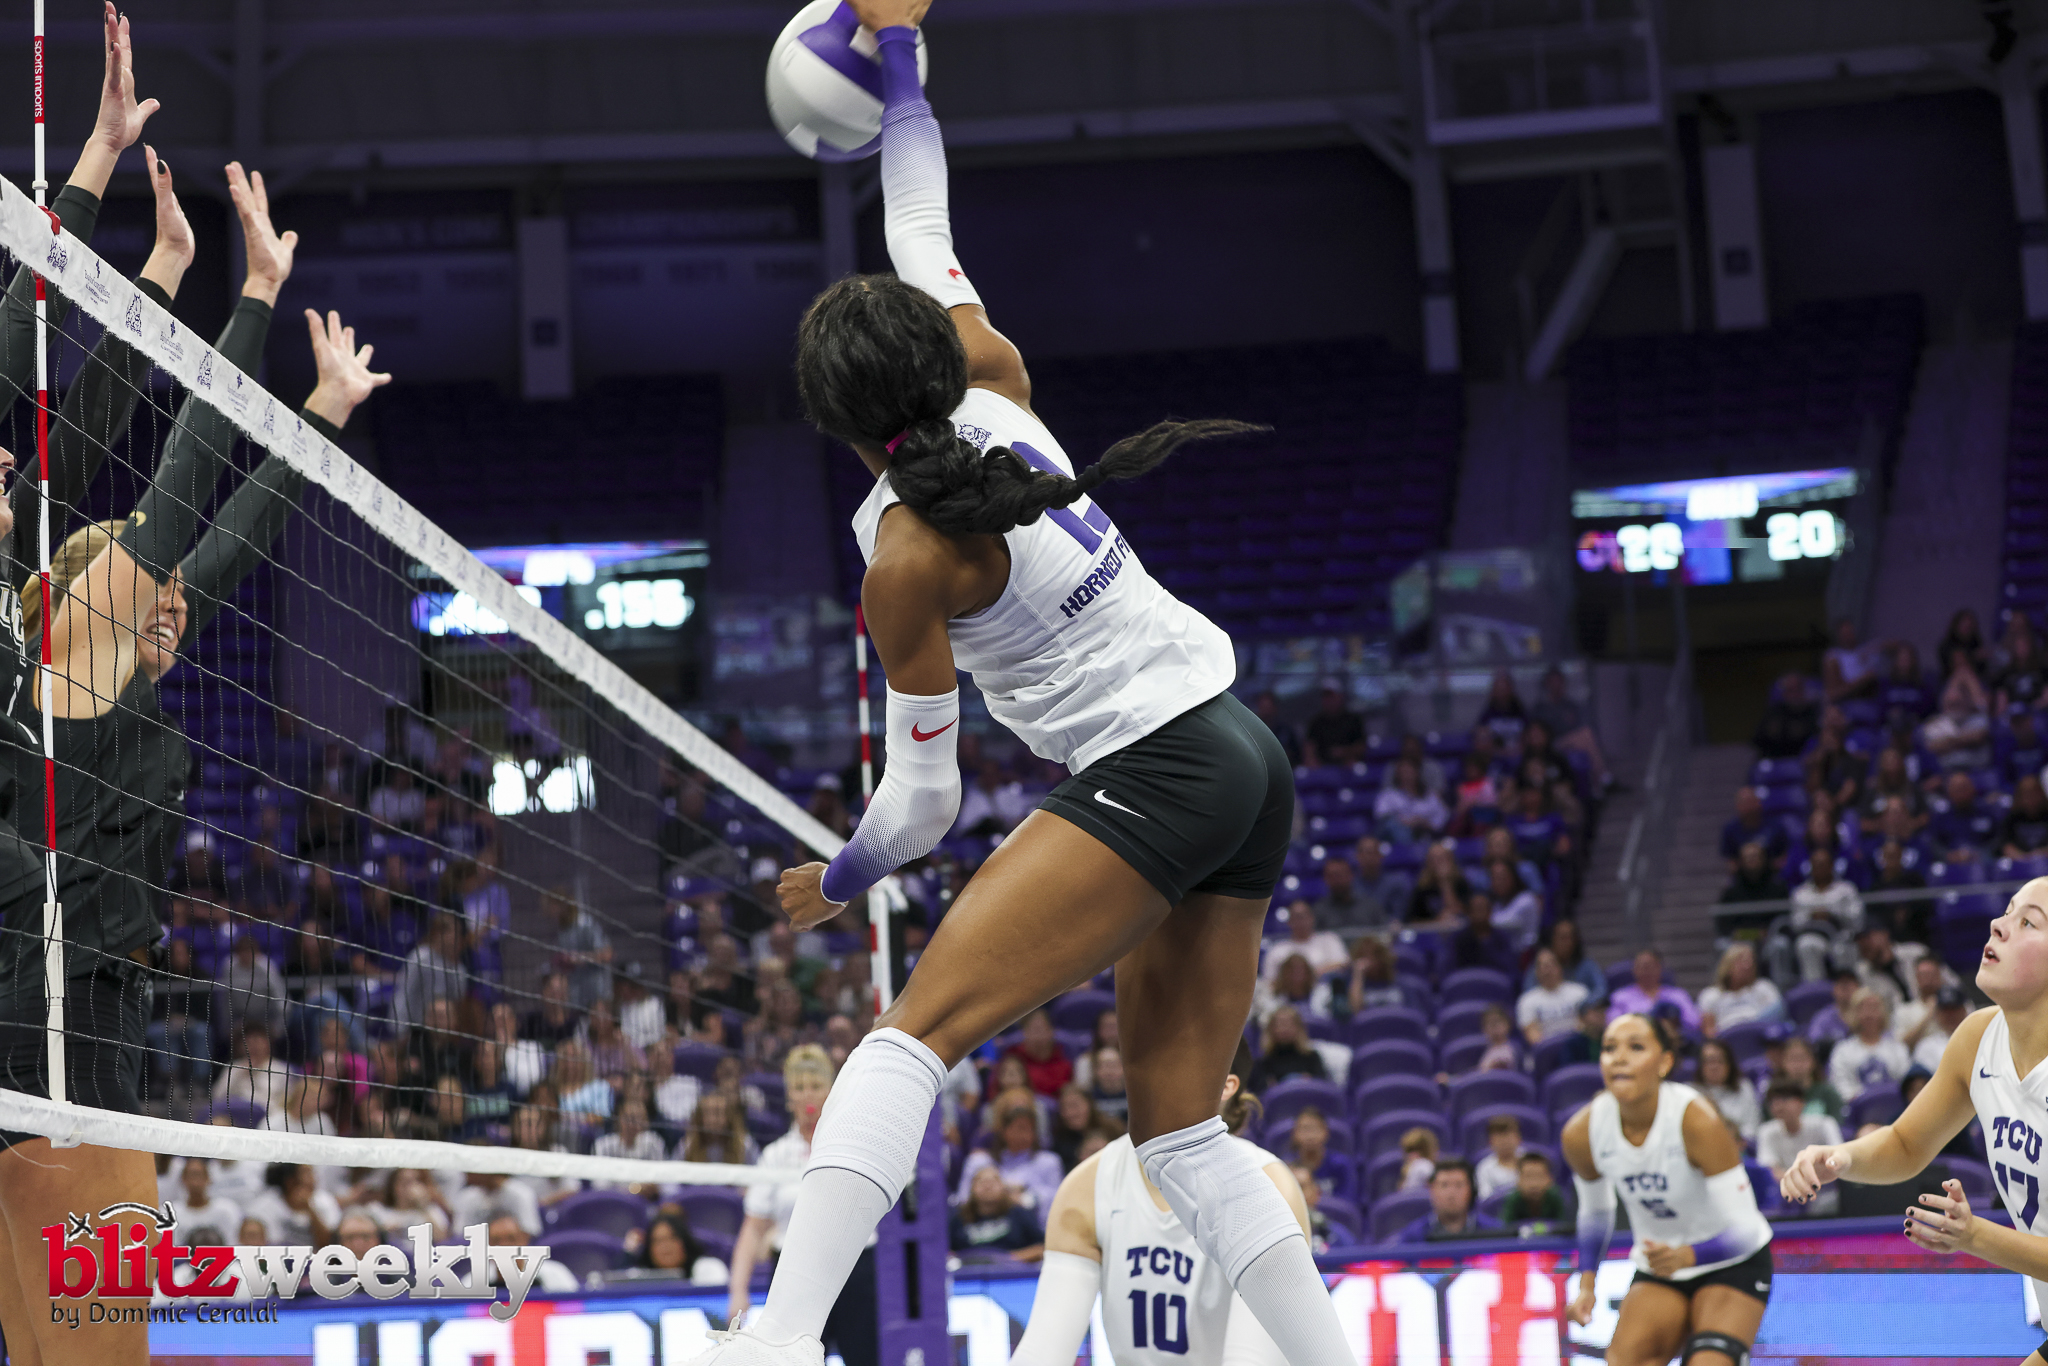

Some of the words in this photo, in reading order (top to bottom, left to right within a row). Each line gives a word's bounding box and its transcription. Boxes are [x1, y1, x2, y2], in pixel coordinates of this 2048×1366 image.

[34, 40, 43, 74] sports
[34, 75, 43, 117] imports
[1767, 509, 1836, 562] 20
[1059, 546, 1123, 618] HORNED
[1993, 1115, 2043, 1165] TCU
[1623, 1172, 1669, 1193] TCU
[1995, 1160, 2040, 1231] 17
[1125, 1245, 1195, 1285] TCU
[1127, 1289, 1190, 1356] 10
